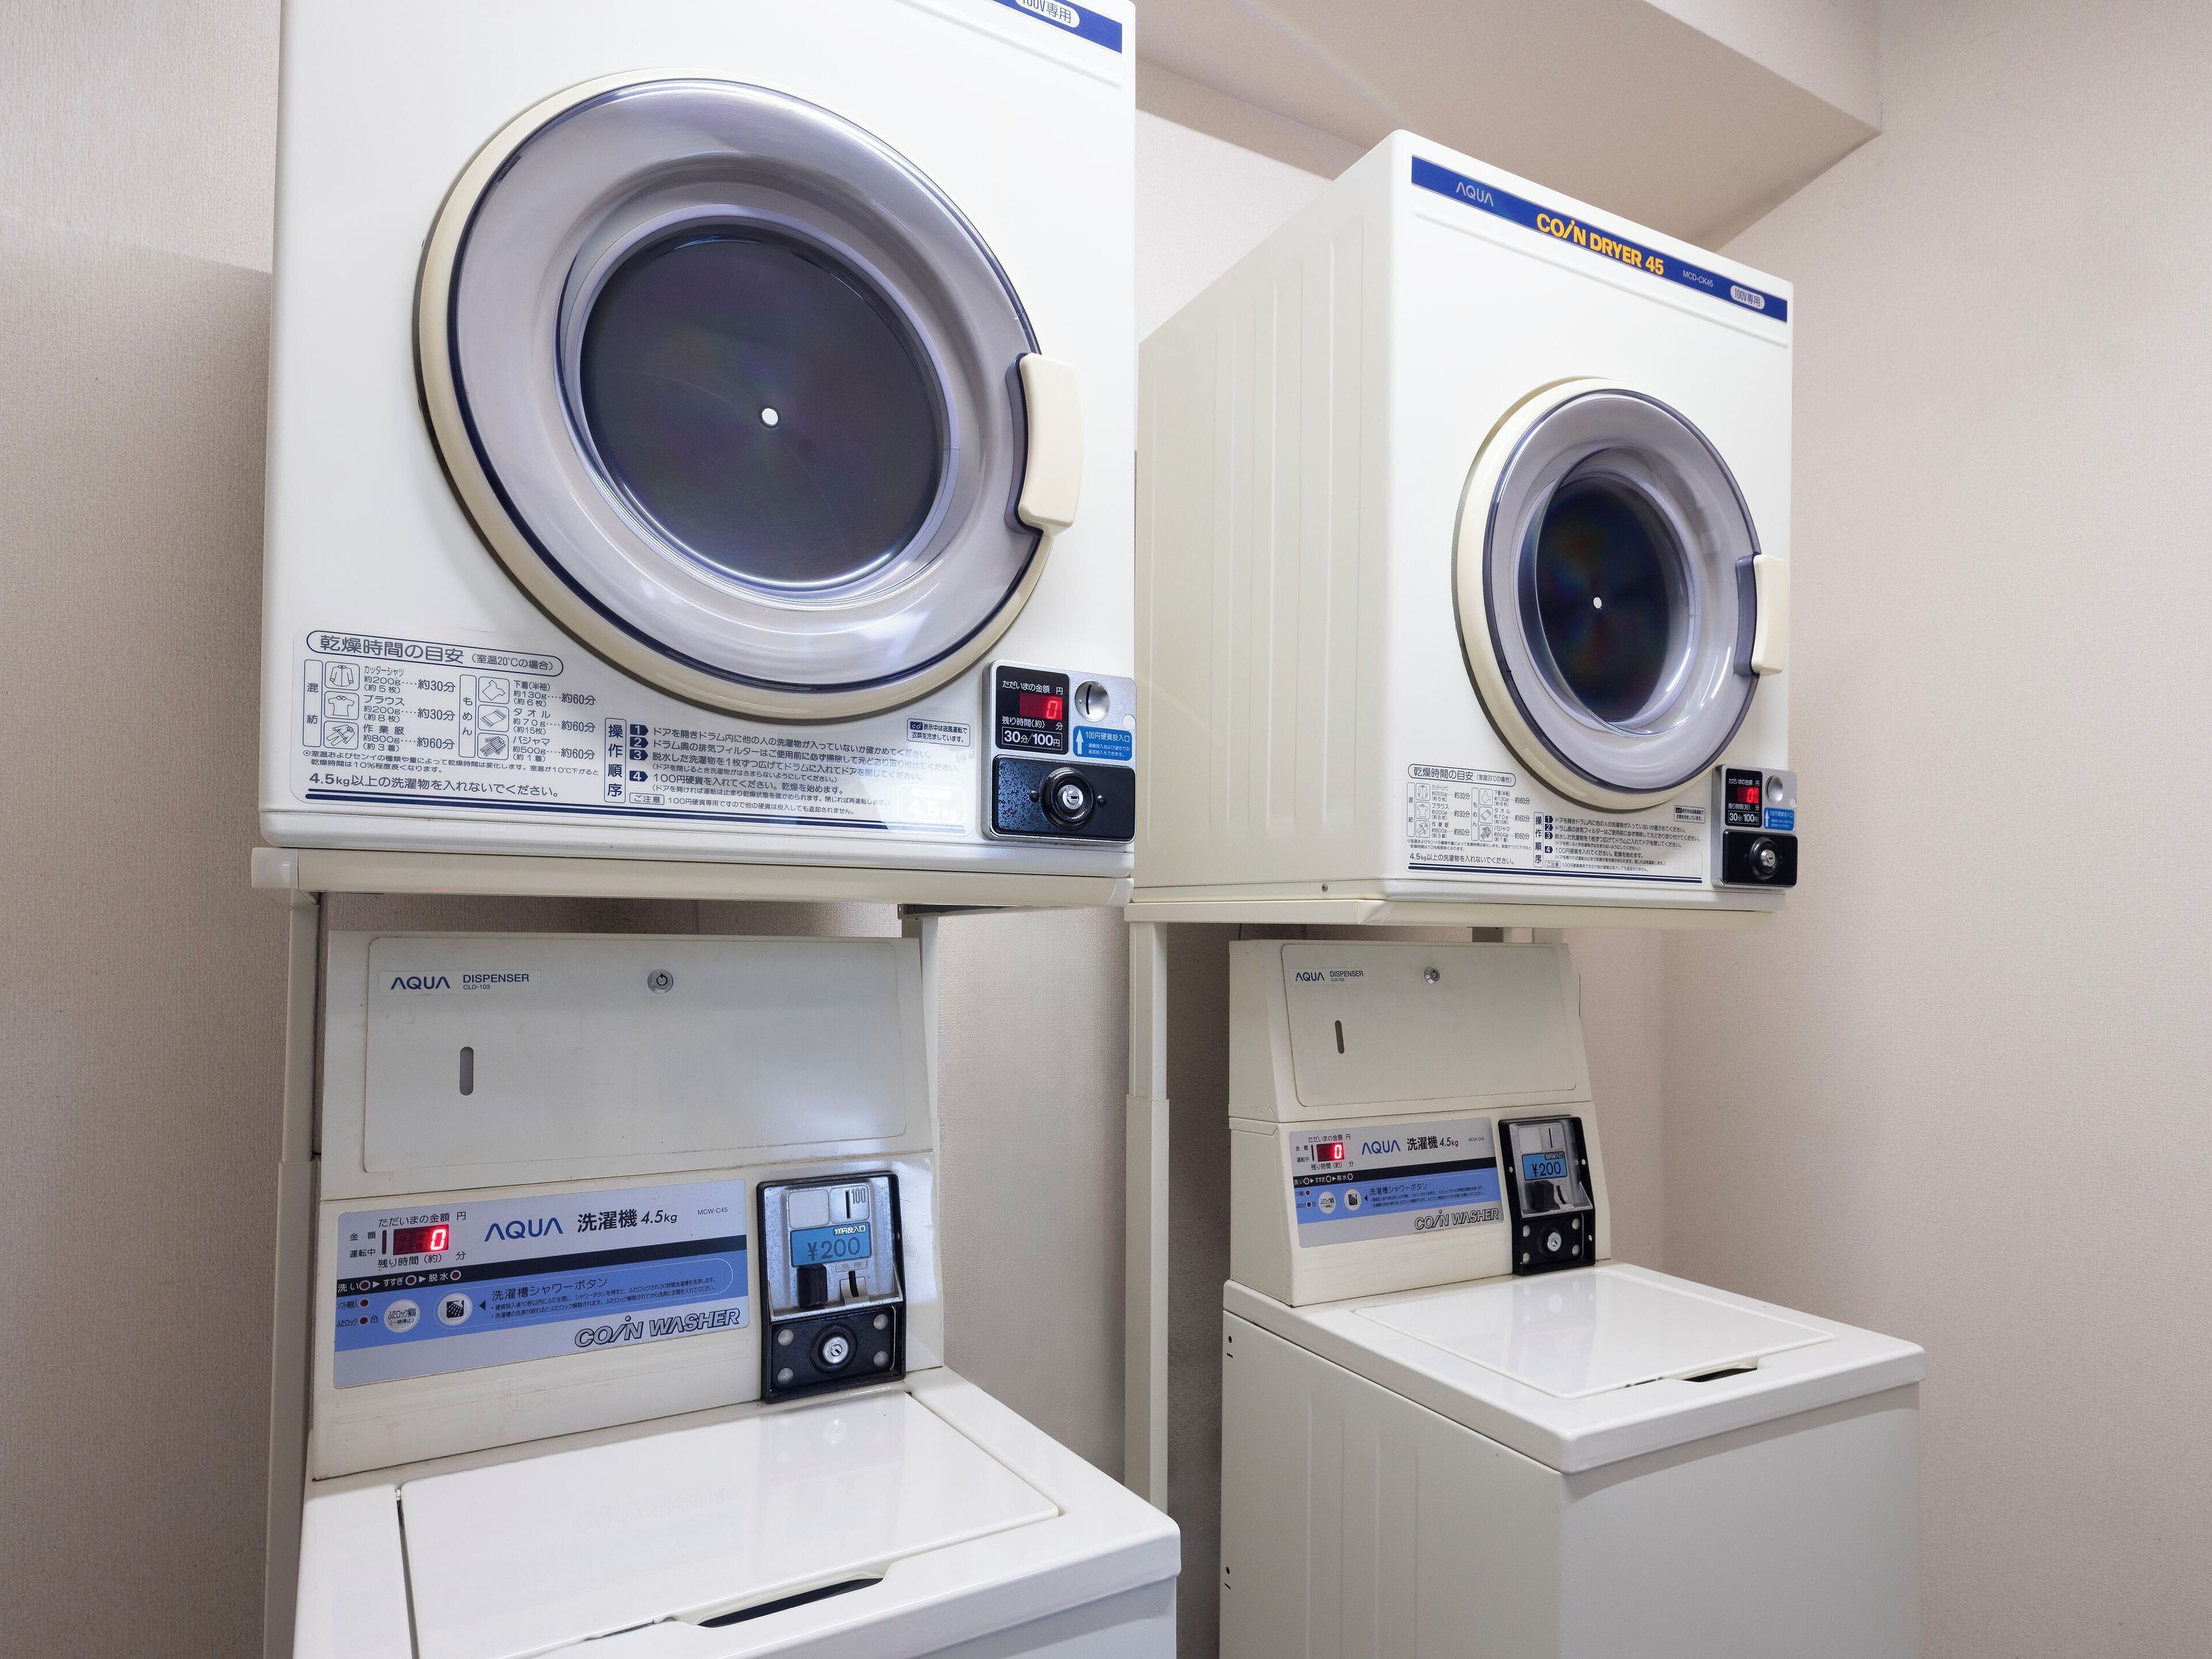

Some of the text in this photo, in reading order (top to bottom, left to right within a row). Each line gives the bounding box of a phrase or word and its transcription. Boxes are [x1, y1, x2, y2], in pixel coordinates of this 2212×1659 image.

[1456, 181, 1494, 207] AQUA
[1536, 213, 1664, 275] COIN DRYER 45
[1683, 270, 1714, 287] MCD-CK45
[1734, 287, 1761, 307] 100V専用
[320, 634, 464, 664] 乾燥時間の目安
[363, 665, 404, 677] カッターシャツ
[363, 676, 456, 692] 約200g 約30分
[1002, 680, 1063, 695] ただいまの金額 円
[363, 695, 404, 706] ブラウス
[513, 690, 596, 706] 約130g 約60分
[363, 706, 455, 721] 約200g 約30分
[462, 696, 474, 736] もめん
[513, 708, 551, 719] タオル
[1046, 700, 1058, 719] 0
[363, 724, 404, 735] 作業服
[513, 718, 596, 733] 約70g 約60分
[634, 725, 641, 735] 1
[1001, 716, 1063, 730] 残り時間（約） 分
[363, 734, 455, 750] 約800g 約60分
[513, 736, 550, 747] パジャマ
[633, 737, 642, 748] 2
[1004, 730, 1061, 747] 30分/100円
[1085, 731, 1131, 743] 100円硬貨投入口
[513, 745, 596, 760] 約500g 約60分
[633, 750, 642, 760] 3
[607, 724, 624, 798] 操作順序
[632, 772, 642, 782] 4
[1413, 766, 1474, 782] 乾燥時間の目安
[309, 772, 559, 798] 4.5kg以上の洗濯物を入れないでください。
[634, 794, 661, 804] ご注意
[1747, 789, 1753, 802] 0
[391, 976, 451, 990] AQUA
[463, 973, 529, 983] DISPENSER
[1296, 972, 1325, 982] AQUA
[1334, 1144, 1342, 1159] 0
[1361, 1136, 1459, 1156] AQUA 洗濯機 4.5kg
[1532, 1161, 1561, 1177] ¥200
[850, 1188, 866, 1205] 100
[697, 1206, 728, 1215] MCW-C45
[378, 1211, 467, 1228] ただいまの金額 円
[484, 1209, 678, 1242] AQUA 洗濯機 4.5kg
[1414, 1208, 1499, 1230] COIN WASHER
[430, 1228, 447, 1251] 0
[349, 1248, 376, 1259] 運転中
[455, 1250, 466, 1261] 分
[807, 1236, 861, 1260] ¥200
[337, 1271, 449, 1293] 洗い すすぎ 脱水
[492, 1278, 608, 1301] 洗濯槽シャワーボタン
[574, 1308, 740, 1348] COIN WASHER
